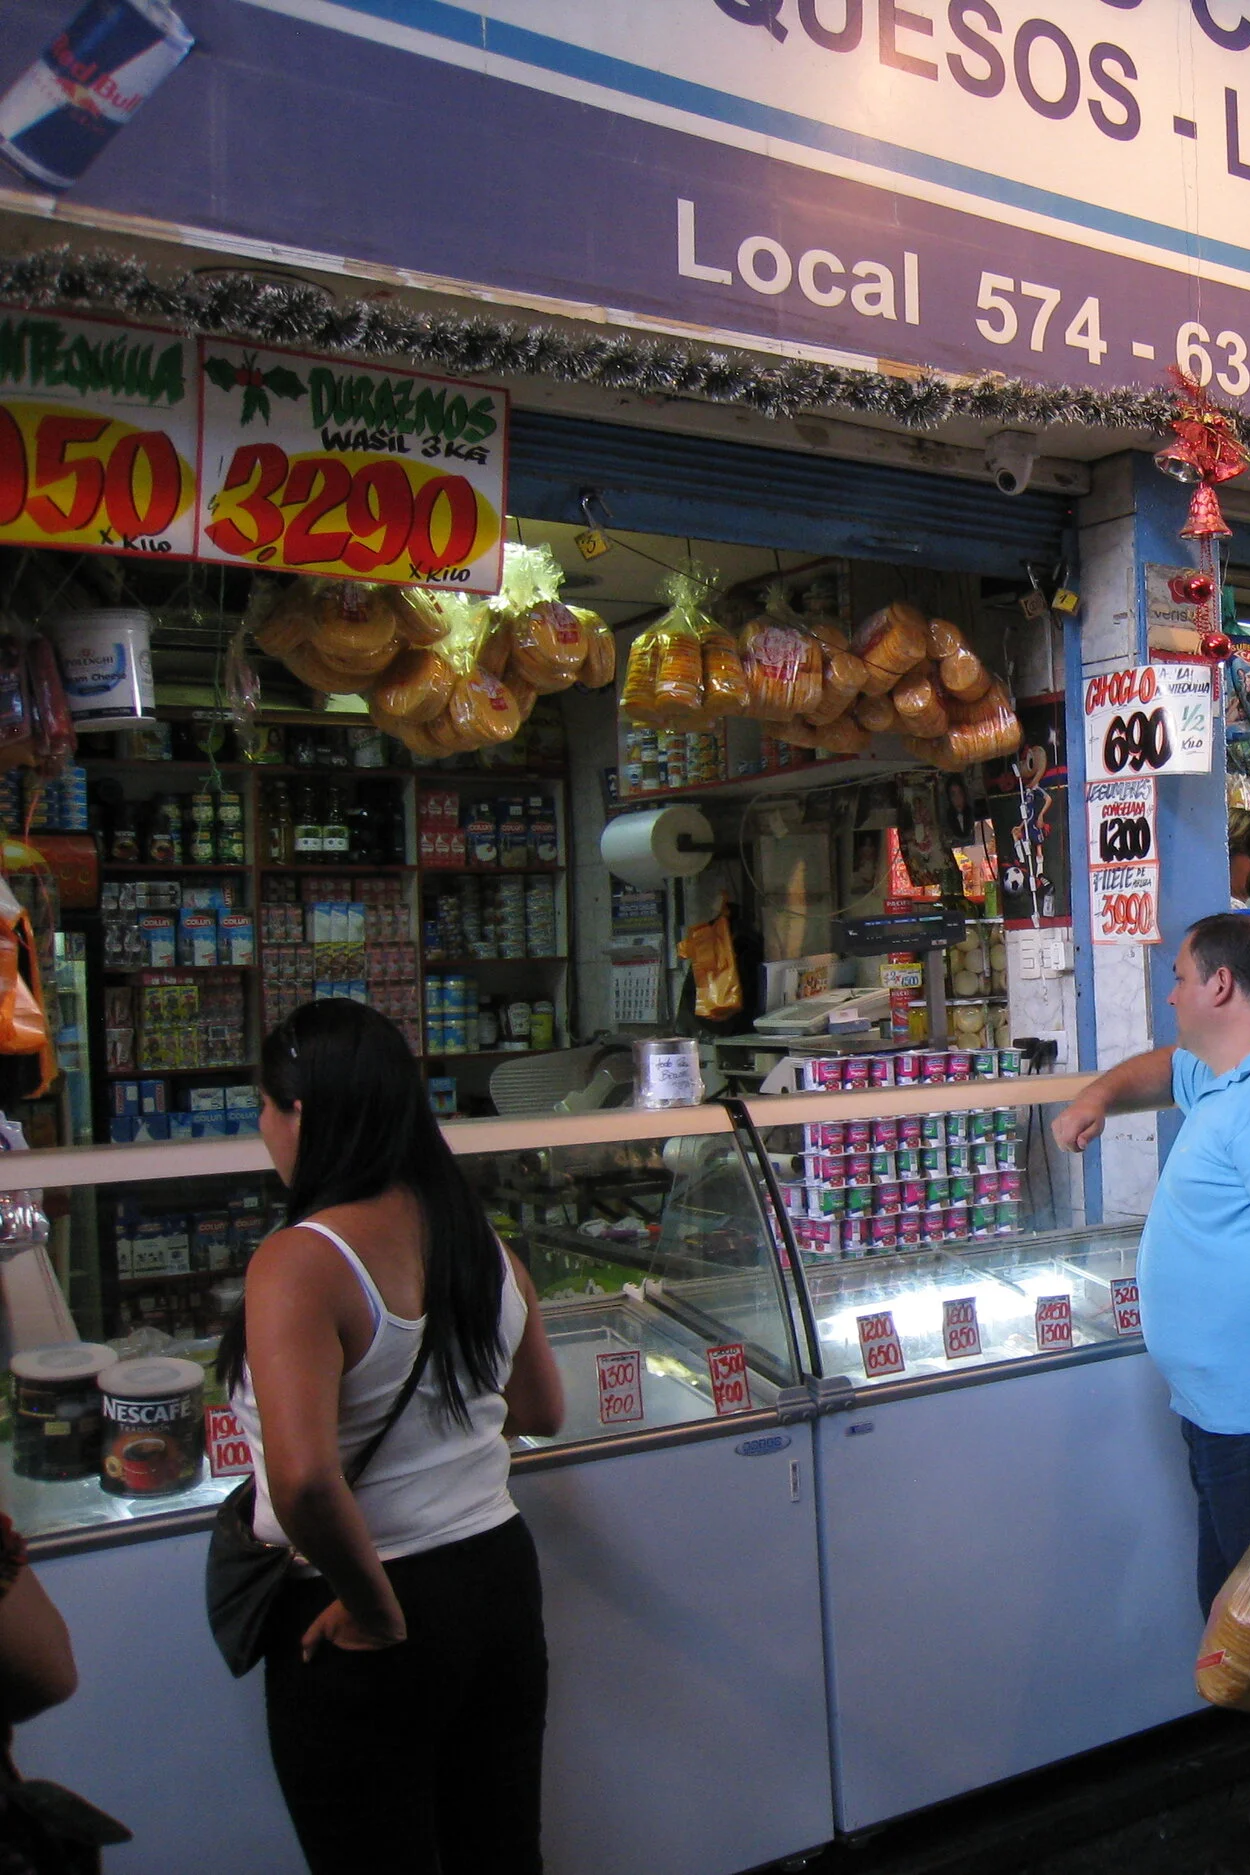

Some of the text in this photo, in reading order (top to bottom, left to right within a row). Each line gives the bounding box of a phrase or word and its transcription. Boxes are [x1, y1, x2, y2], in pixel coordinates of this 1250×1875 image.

[677, 198, 920, 326] Local
[975, 271, 1108, 366] 574
[308, 367, 497, 443] DURAZNOS
[321, 427, 409, 453] WASIL
[1104, 707, 1173, 775] 690
[861, 1317, 894, 1343] 1200
[949, 1326, 976, 1351] 850
[867, 1343, 899, 1369] 650
[600, 1363, 634, 1391] 1300
